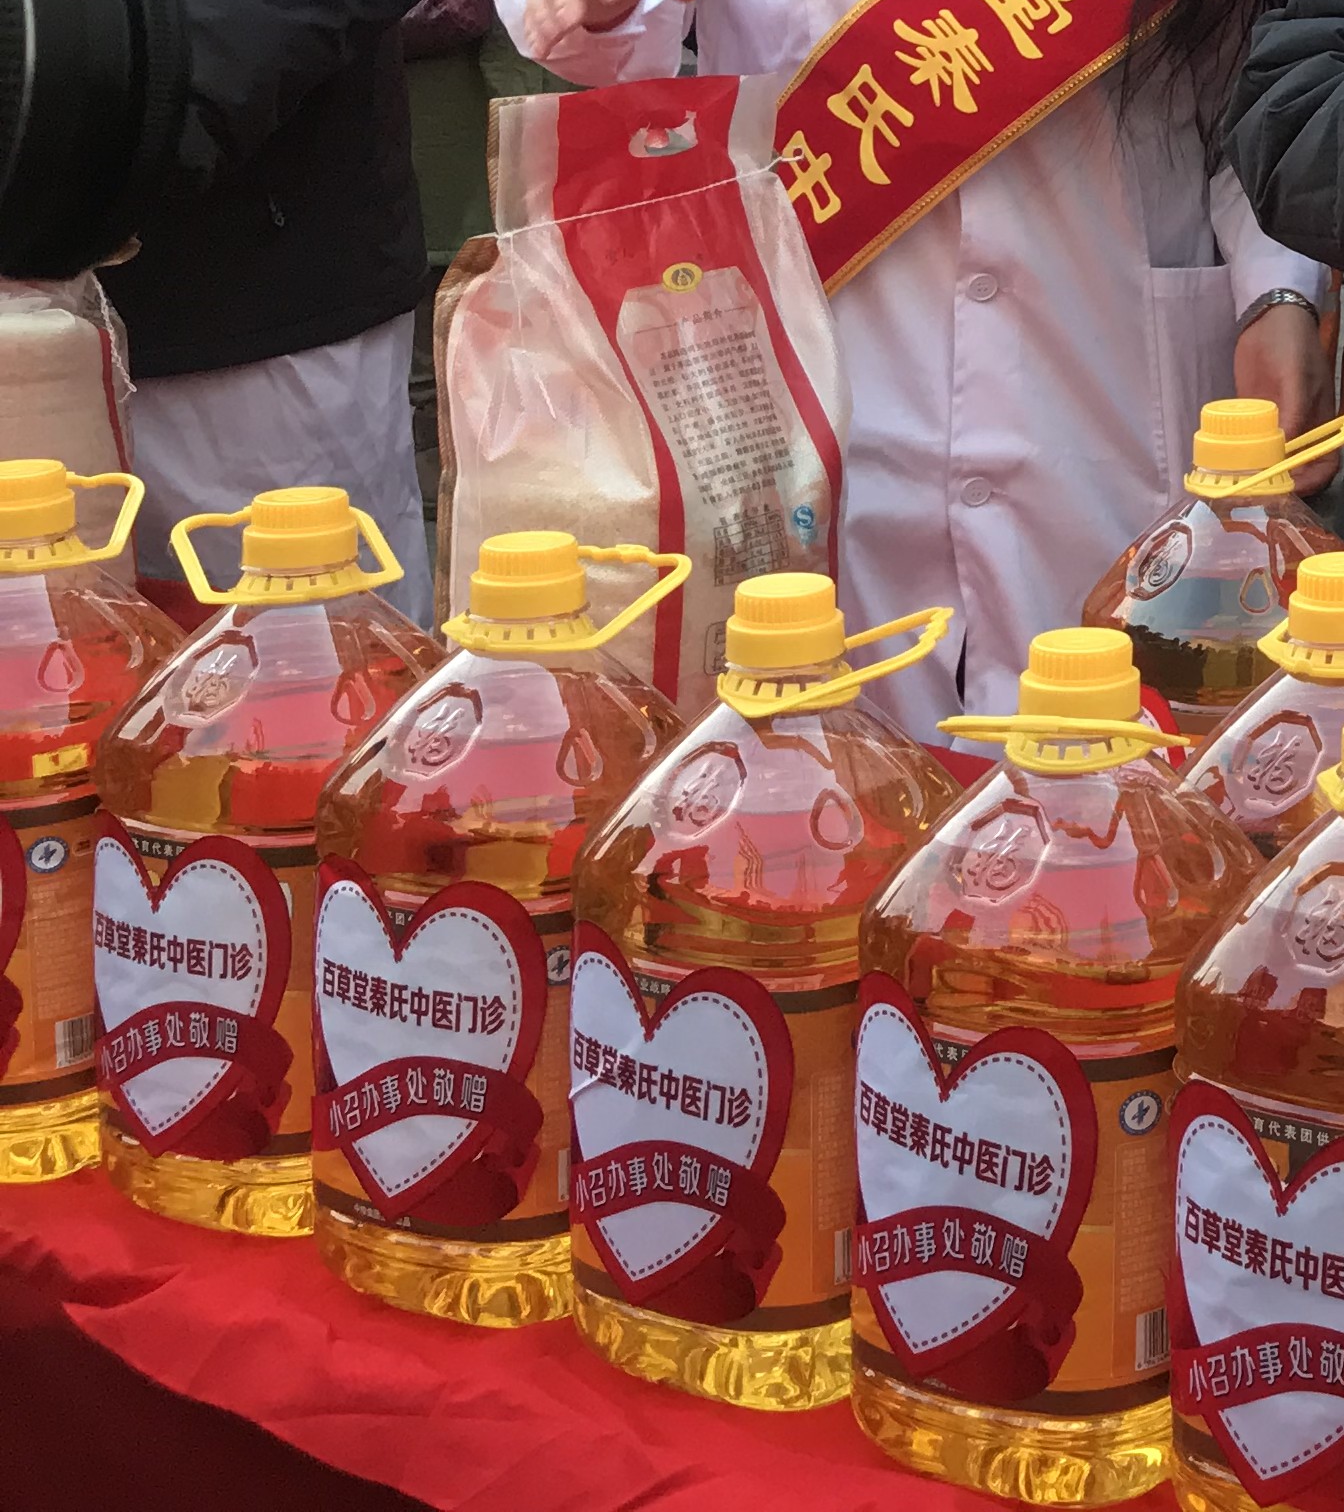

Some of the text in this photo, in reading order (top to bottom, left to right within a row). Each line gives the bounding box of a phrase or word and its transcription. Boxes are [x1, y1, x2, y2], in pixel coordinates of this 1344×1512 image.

[95, 910, 254, 981] 百草堂秦氏中医门诊
[322, 957, 508, 1035] 百草堂秦氏中医门诊
[102, 1011, 239, 1079] 小召办事处敬赠
[573, 1028, 753, 1129] 百草堂秦氏中医门诊
[329, 1067, 488, 1138] 小召办事处敬赠
[859, 1079, 1056, 1196] 百草堂秦氏中医门诊
[575, 1151, 732, 1212] 小召办事处敬赠
[858, 1218, 1030, 1279] 小召办事处敬赠
